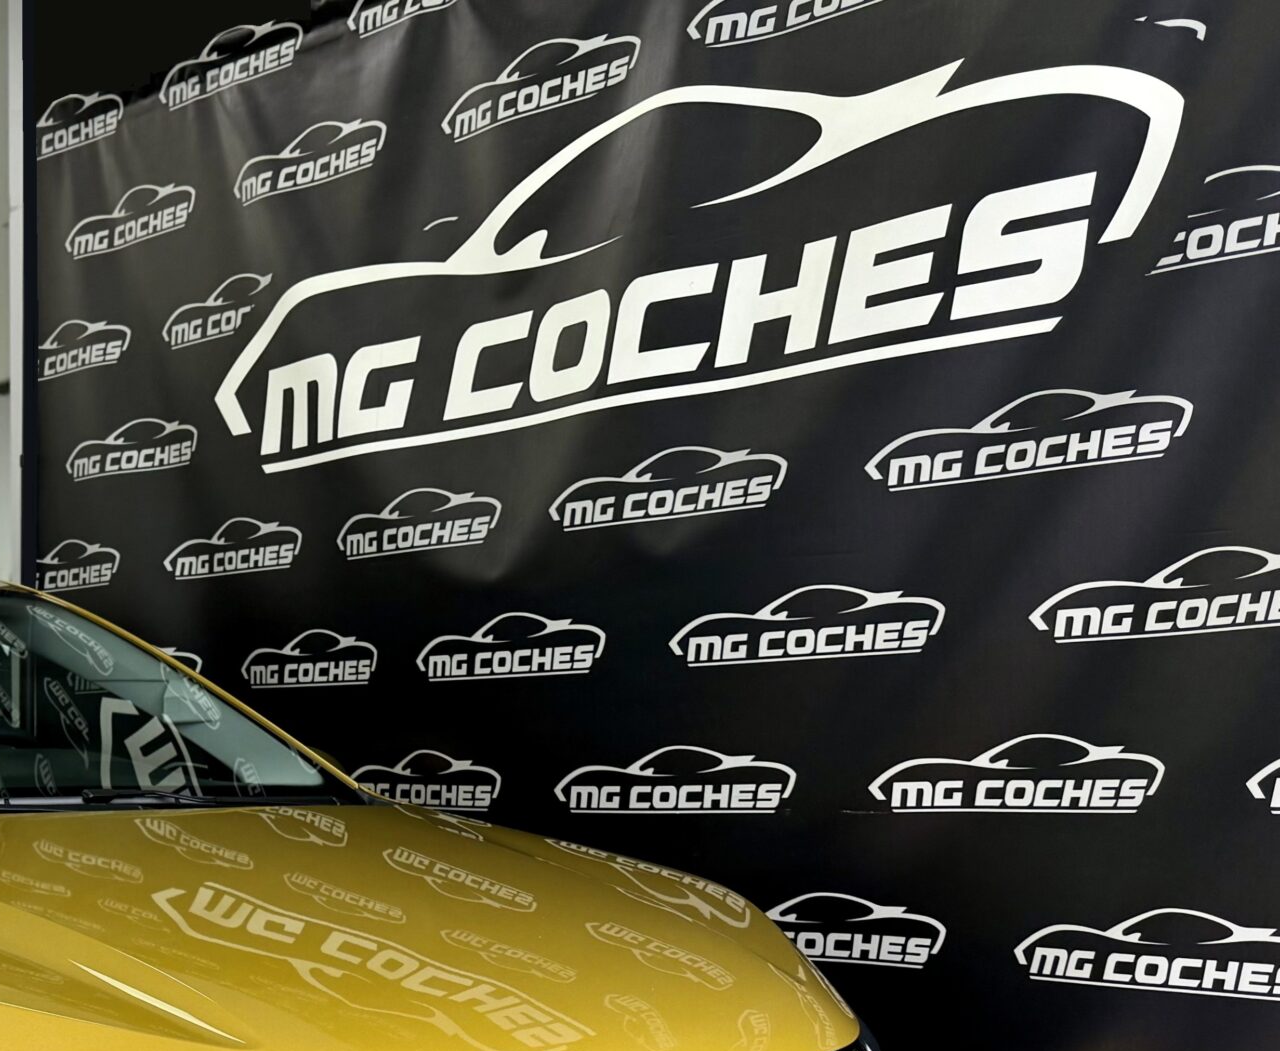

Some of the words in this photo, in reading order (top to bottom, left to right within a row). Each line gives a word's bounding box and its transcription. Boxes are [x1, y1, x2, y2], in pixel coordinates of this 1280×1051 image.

[705, 5, 778, 44] MG
[168, 76, 201, 106] MG
[206, 39, 296, 87] COCHES
[453, 101, 491, 138] MG
[497, 55, 630, 120] COCHES
[41, 109, 118, 155] COCHES
[242, 170, 273, 201] MG
[277, 138, 378, 189] COCHES
[73, 229, 109, 257] MG
[113, 202, 189, 247] COCHES
[170, 319, 201, 346] MG
[261, 336, 421, 456] MG
[443, 172, 1097, 421] COCHES
[43, 340, 123, 377] COCHES
[73, 456, 101, 478] MG
[105, 441, 192, 470] COCHES
[887, 450, 963, 486] MG
[974, 420, 1173, 476] COCHES
[565, 494, 614, 525] MG
[620, 474, 773, 519] COCHES
[345, 530, 379, 556] MG
[382, 515, 492, 551] COCHES
[43, 562, 114, 590] COCHES
[175, 554, 209, 577] MG
[214, 543, 295, 571] COCHES
[1054, 604, 1134, 638] MG
[687, 633, 748, 662] MG
[758, 620, 930, 657] COCHES
[249, 665, 280, 685] MG
[284, 660, 371, 682] COCHES
[428, 653, 468, 678] MG
[475, 645, 594, 676] COCHES
[394, 782, 491, 808] COCHES
[570, 783, 621, 809] MG
[628, 783, 783, 809] COCHES
[891, 780, 963, 807] MG
[974, 779, 1149, 807] COCHES
[783, 931, 931, 962] OCHES
[1030, 947, 1094, 979] MG
[1103, 953, 1280, 994] COCHE
